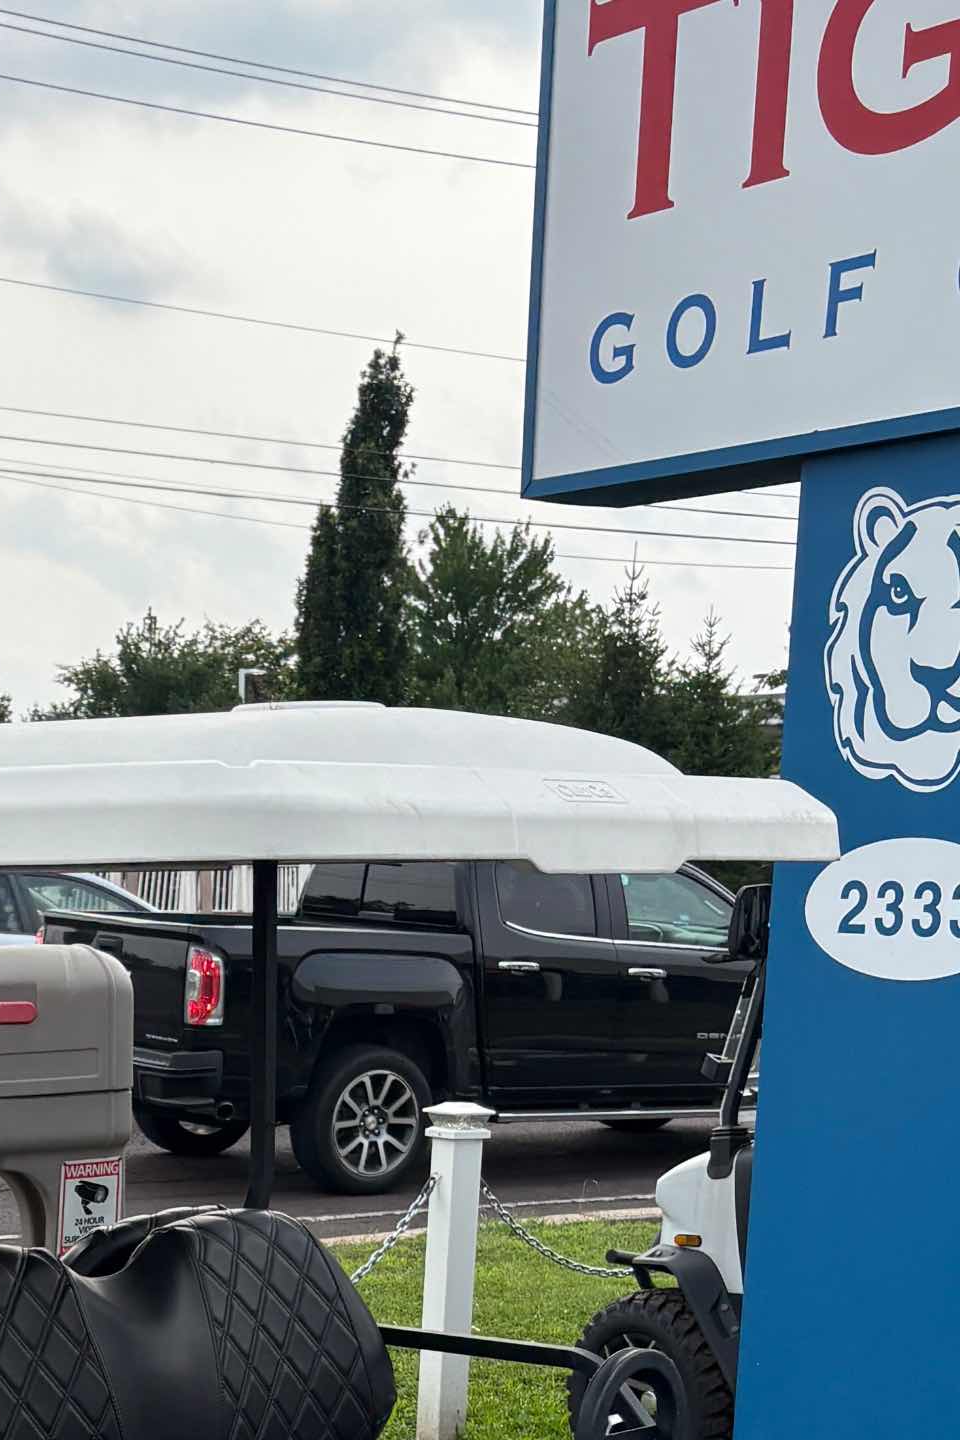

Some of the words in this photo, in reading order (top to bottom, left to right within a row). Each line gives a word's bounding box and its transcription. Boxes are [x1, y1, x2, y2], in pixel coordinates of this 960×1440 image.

[589, 249, 877, 385] GOLF
[66, 1161, 119, 1178] WARNING
[75, 1218, 83, 1226] 24
[84, 1216, 104, 1225] HOUR
